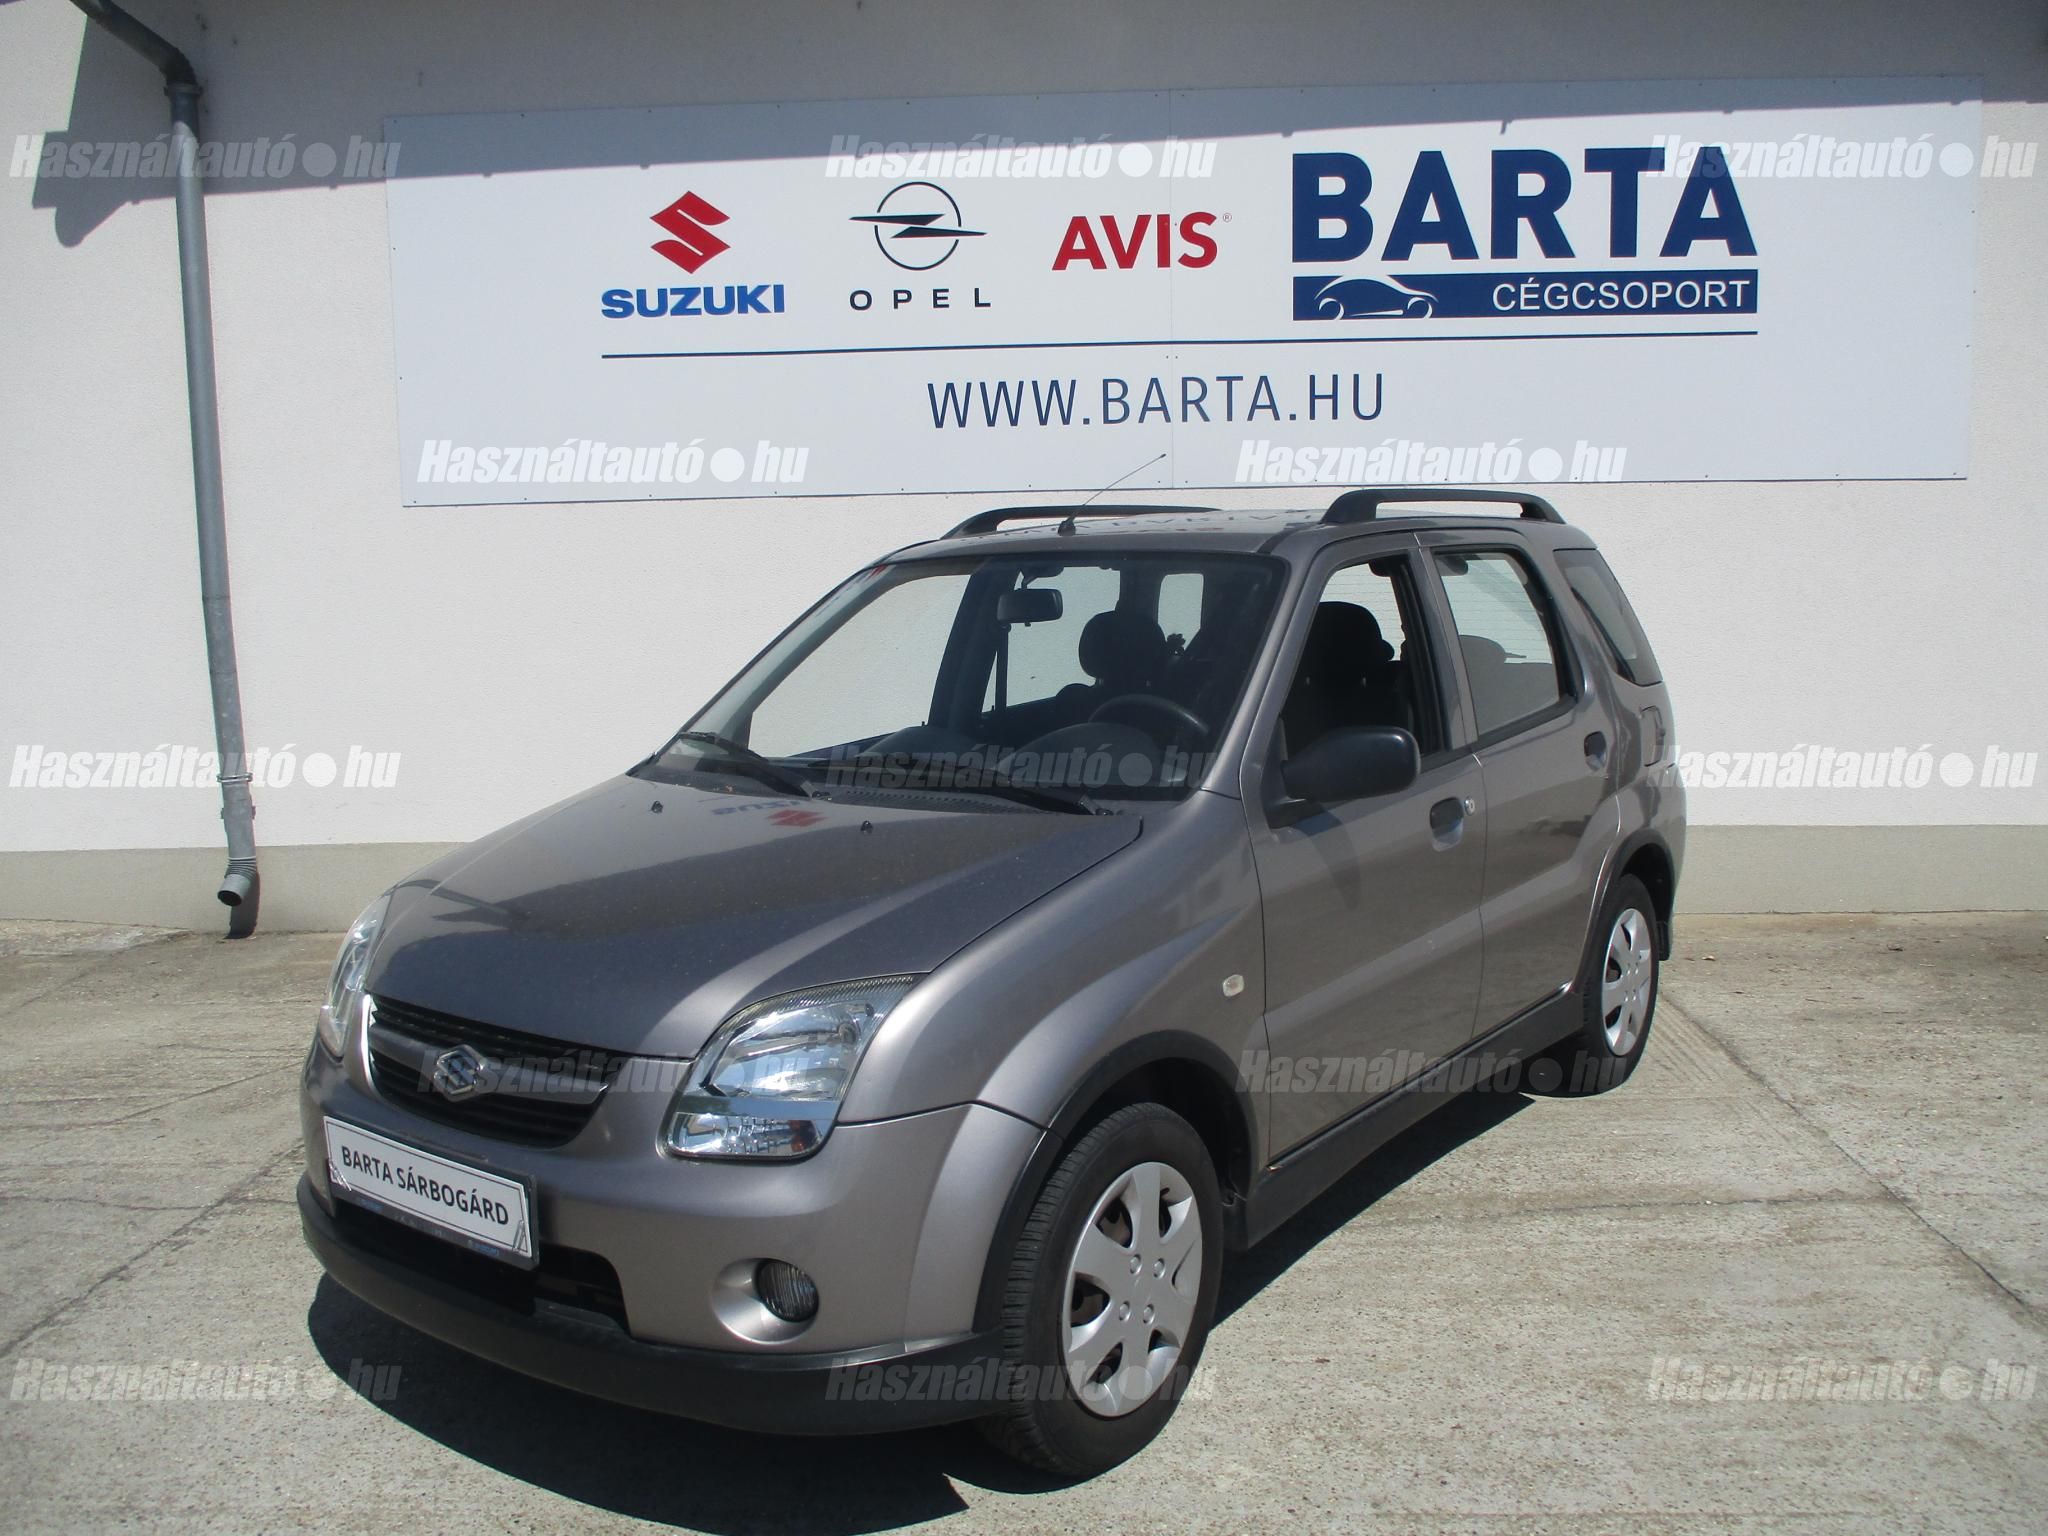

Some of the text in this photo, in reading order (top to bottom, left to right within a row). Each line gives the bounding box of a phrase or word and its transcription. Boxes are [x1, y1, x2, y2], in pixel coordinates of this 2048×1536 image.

[1292, 146, 1758, 263] BARTA
[1052, 211, 1218, 271] AVIS
[601, 284, 786, 319] SUZUKI
[849, 288, 992, 312] OPEL
[1491, 276, 1752, 312] CÉGCSOPORT
[927, 373, 1385, 429] WWW.BARTA.HU
[341, 1146, 394, 1185] BARTA
[396, 1166, 510, 1226] SÁRBOGÁRD
